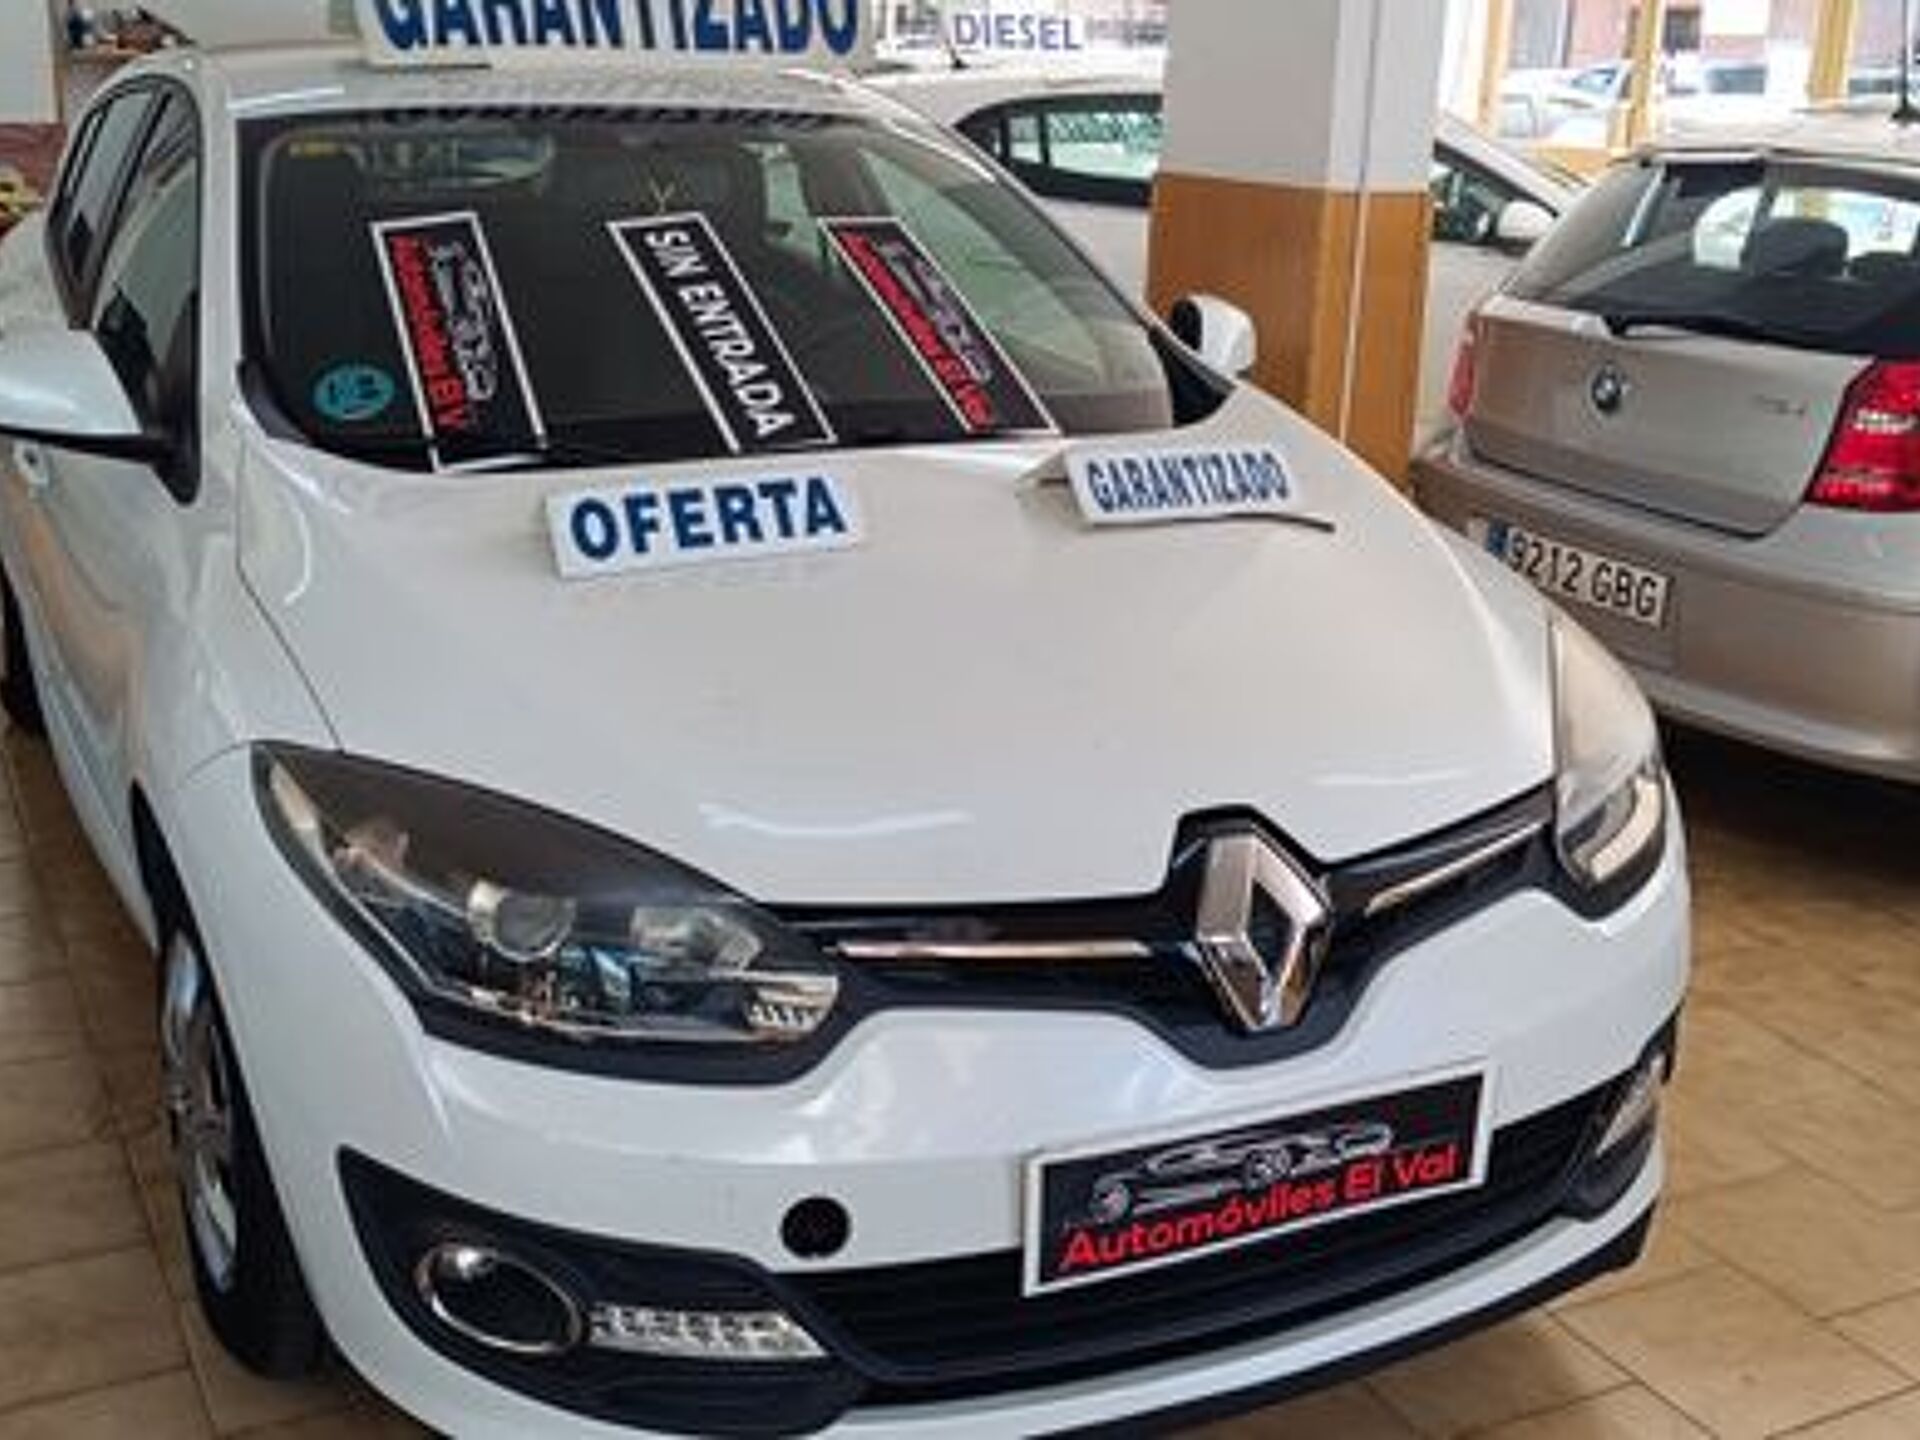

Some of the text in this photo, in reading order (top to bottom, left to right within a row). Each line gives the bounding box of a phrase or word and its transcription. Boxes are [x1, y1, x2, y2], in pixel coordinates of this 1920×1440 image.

[954, 14, 1084, 50] DIESEL
[645, 230, 795, 436] SIN ENTRADA
[570, 477, 847, 561] OFERTA
[1087, 452, 1290, 512] GARANTIZADO
[1508, 530, 1658, 617] 9212 GBG
[1060, 1144, 1456, 1272] Automóviles El Val
